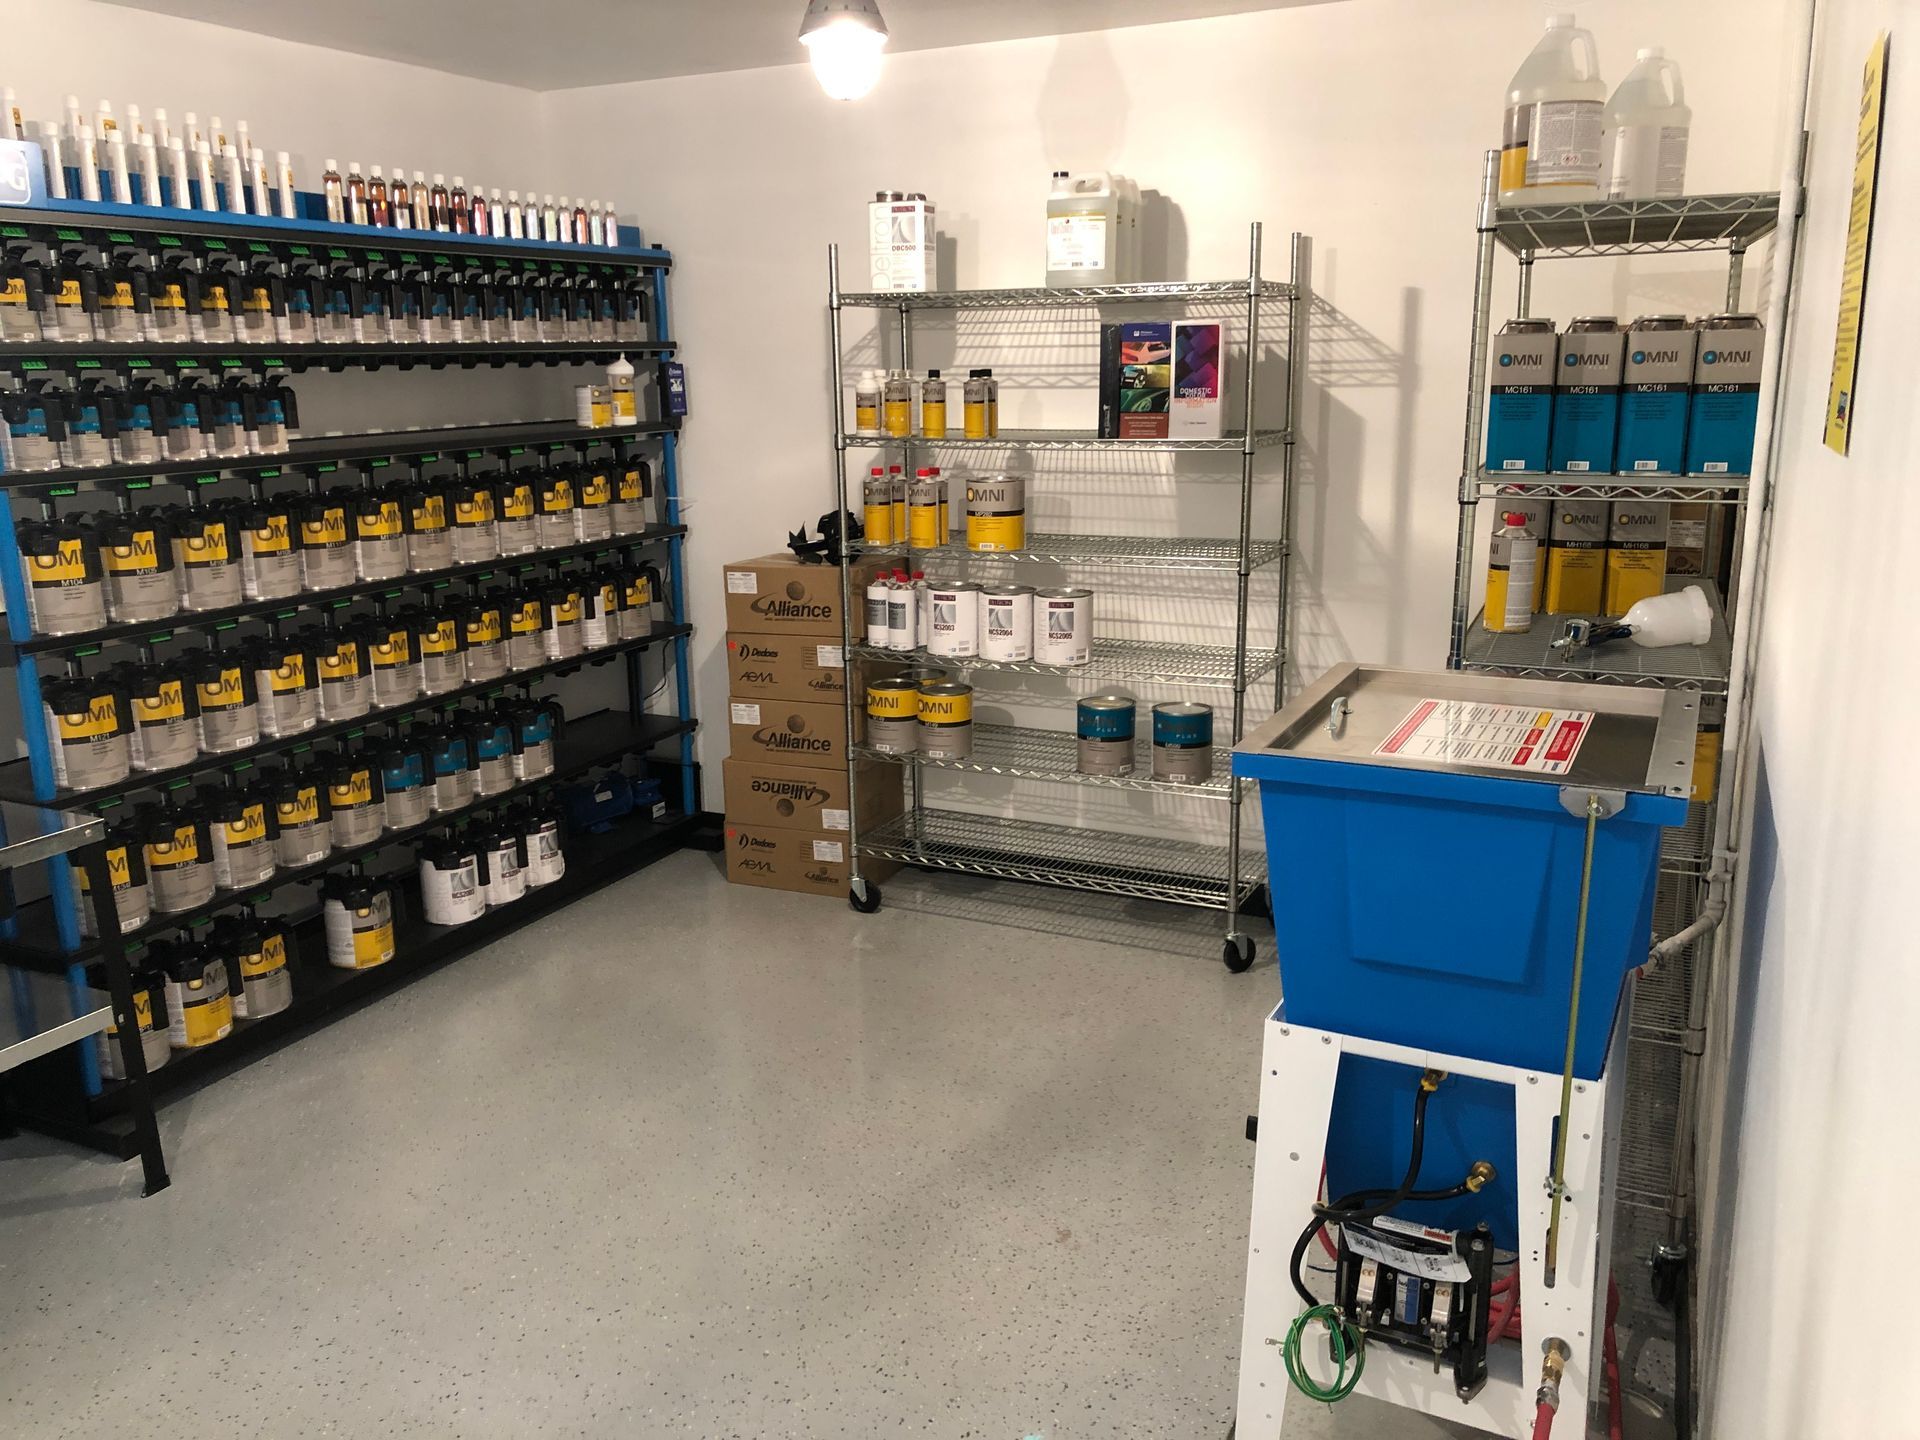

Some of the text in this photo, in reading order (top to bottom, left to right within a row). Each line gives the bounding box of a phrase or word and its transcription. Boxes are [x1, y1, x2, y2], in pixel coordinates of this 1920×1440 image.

[1499, 353, 1544, 367] OMNI
[1564, 353, 1609, 367] OMNI
[1632, 350, 1679, 365] OMNI
[1702, 350, 1751, 365] OMNI
[1505, 386, 1533, 394] MC161
[1570, 386, 1599, 394] MC161
[1637, 384, 1667, 392] MC161
[1708, 384, 1739, 393] MC161
[966, 487, 1005, 502] OMNI
[1500, 510, 1536, 522] ONI
[1562, 513, 1599, 525] OMNI
[1619, 513, 1657, 526] OMNI
[61, 579, 83, 587] M104
[764, 600, 832, 618] Alliance
[988, 629, 1013, 637] NCS2004
[1049, 632, 1073, 640] NCS2005
[814, 682, 844, 690] Alliance
[867, 693, 899, 709] OMNI
[917, 698, 953, 714] OMNI
[766, 732, 832, 752] Alliance
[752, 779, 817, 801] Alliance
